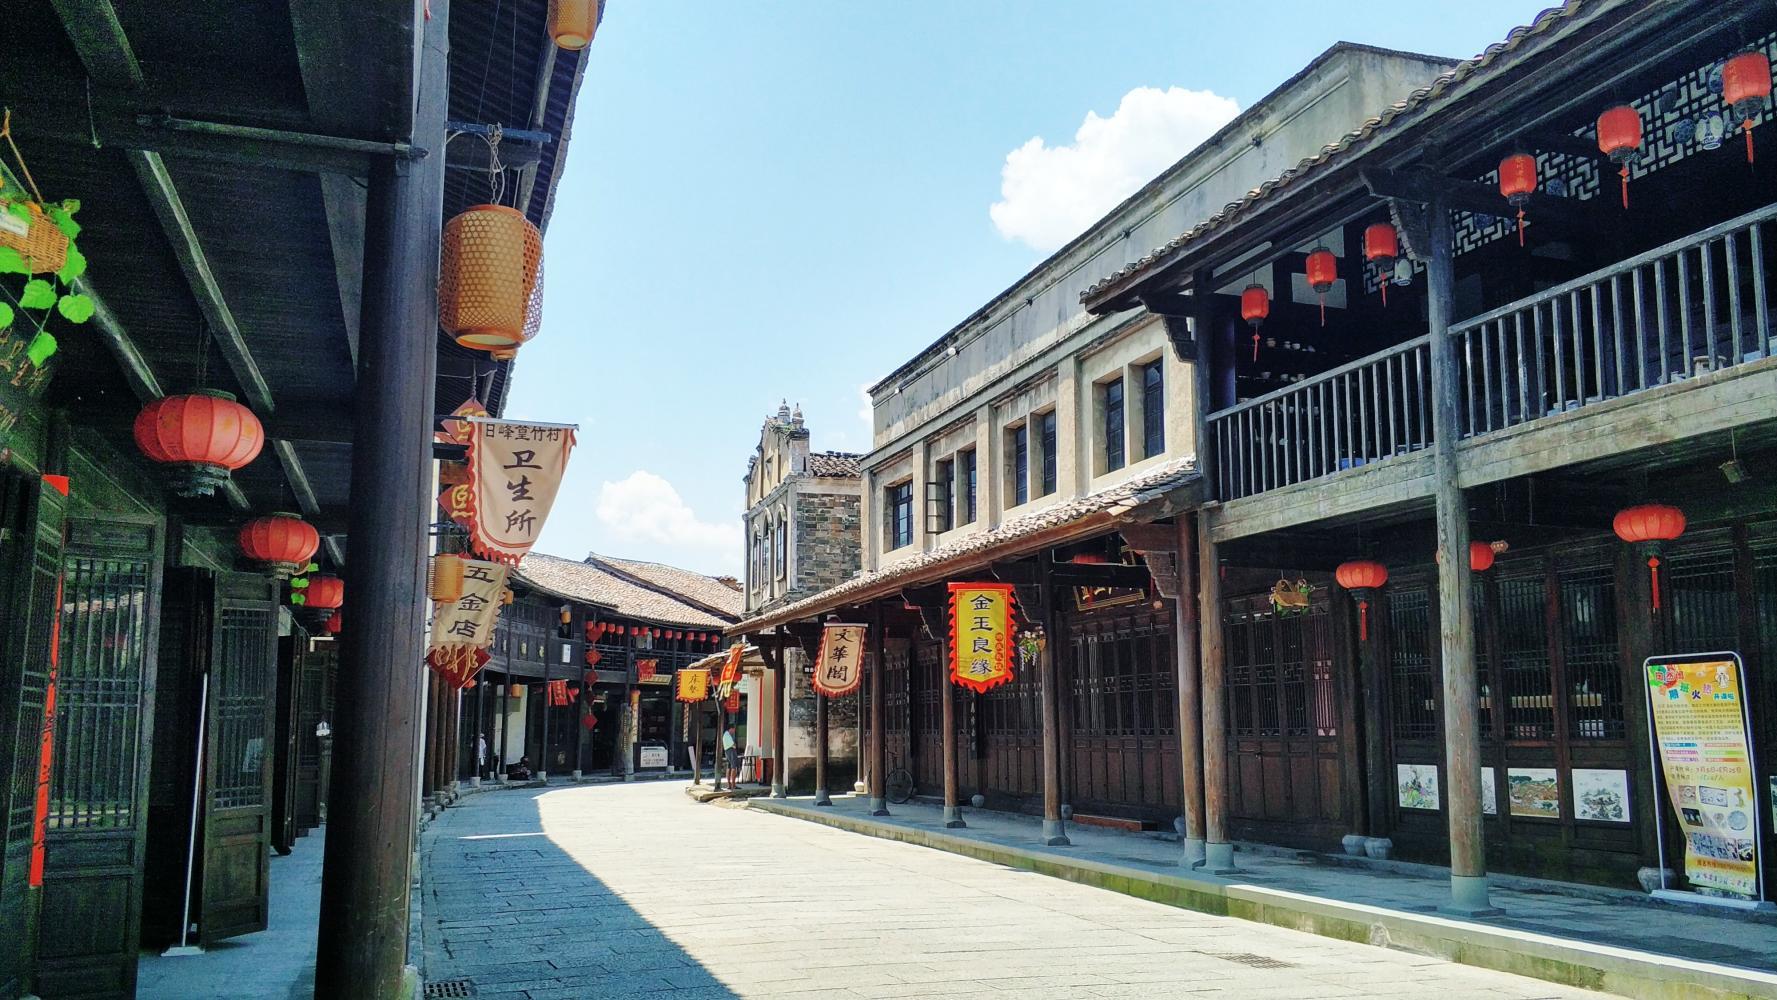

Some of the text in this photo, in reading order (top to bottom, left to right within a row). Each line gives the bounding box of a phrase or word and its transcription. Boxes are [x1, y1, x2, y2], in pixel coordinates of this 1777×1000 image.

[486, 424, 561, 442] 日峰篁竹村
[503, 449, 542, 536] 卫生所
[447, 565, 495, 638] 五金店
[970, 594, 994, 674] 金玉良缘
